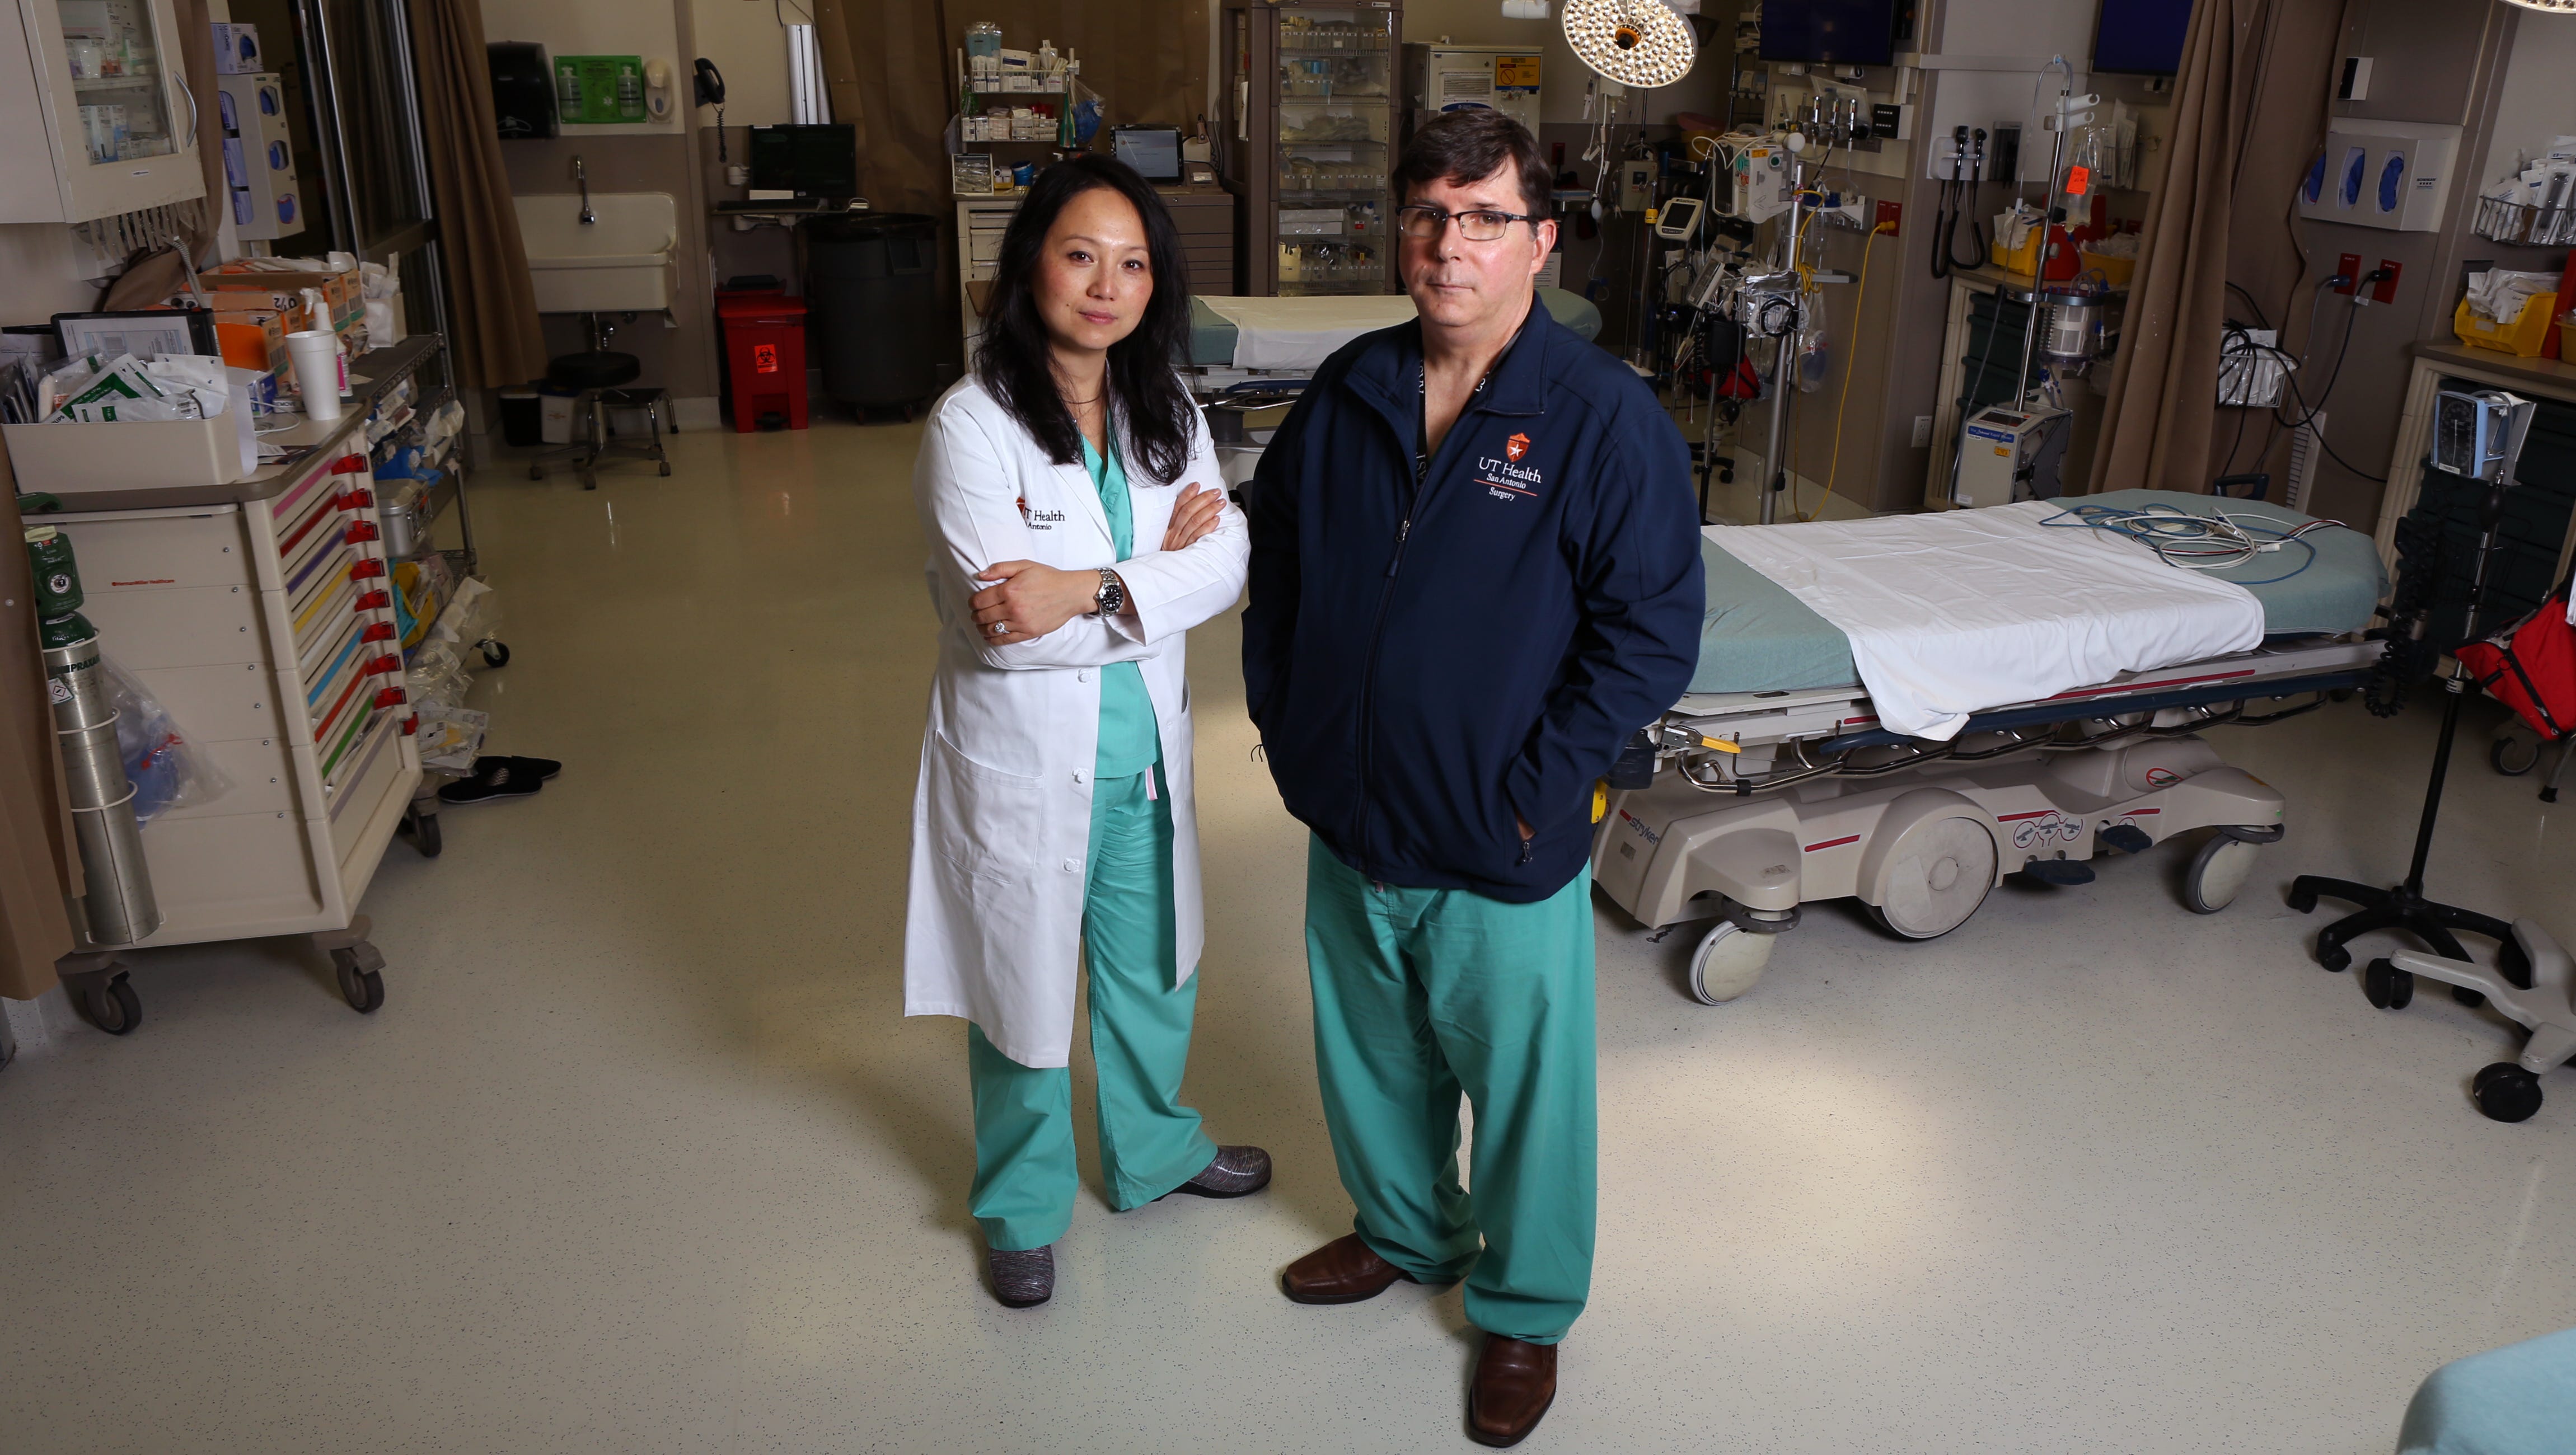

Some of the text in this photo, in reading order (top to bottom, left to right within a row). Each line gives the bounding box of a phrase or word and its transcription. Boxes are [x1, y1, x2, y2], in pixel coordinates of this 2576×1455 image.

[51, 415, 65, 424] LIPS
[1478, 457, 1542, 484] UT Health
[1486, 473, 1526, 489] San Antonio
[1489, 486, 1516, 501] Surgery
[1034, 510, 1065, 522] Health
[1027, 522, 1052, 530] Antonio
[1629, 817, 1660, 846] stryker
